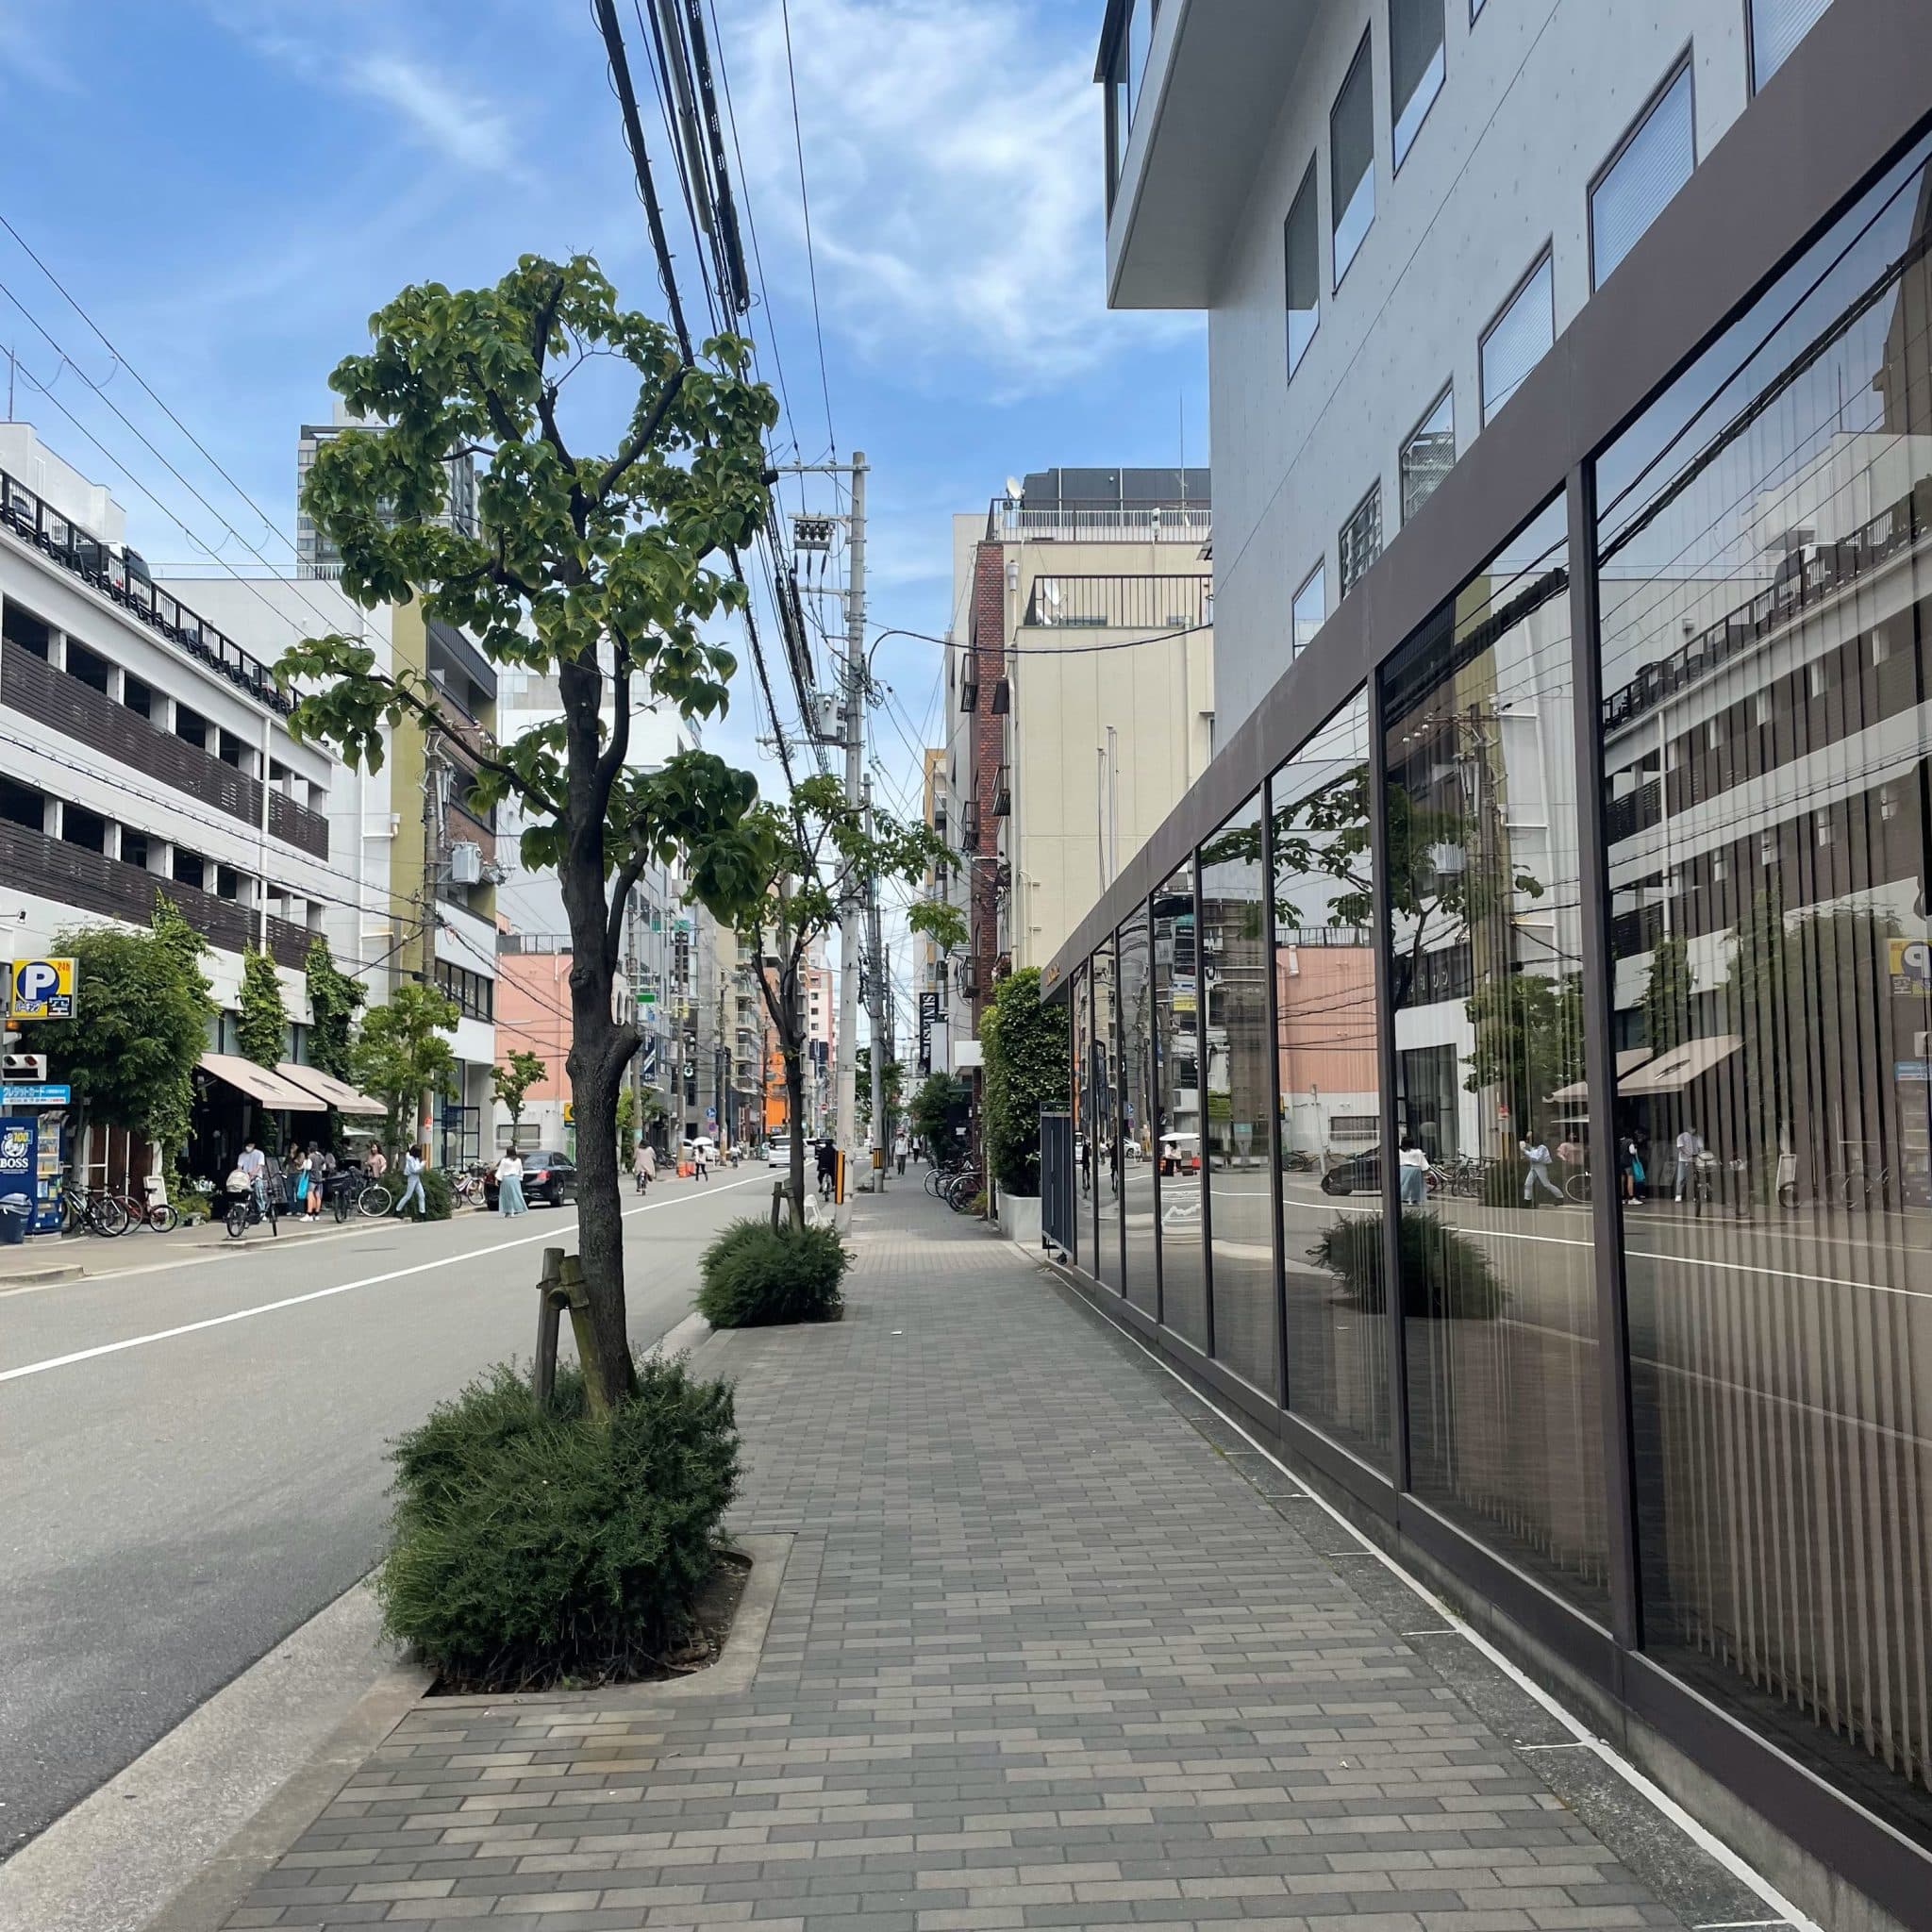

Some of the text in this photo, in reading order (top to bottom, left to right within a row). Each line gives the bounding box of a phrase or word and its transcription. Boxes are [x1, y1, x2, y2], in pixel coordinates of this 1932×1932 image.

[25, 965, 57, 1000] P
[48, 995, 70, 1016] 空
[0, 1158, 28, 1168] BOSS
